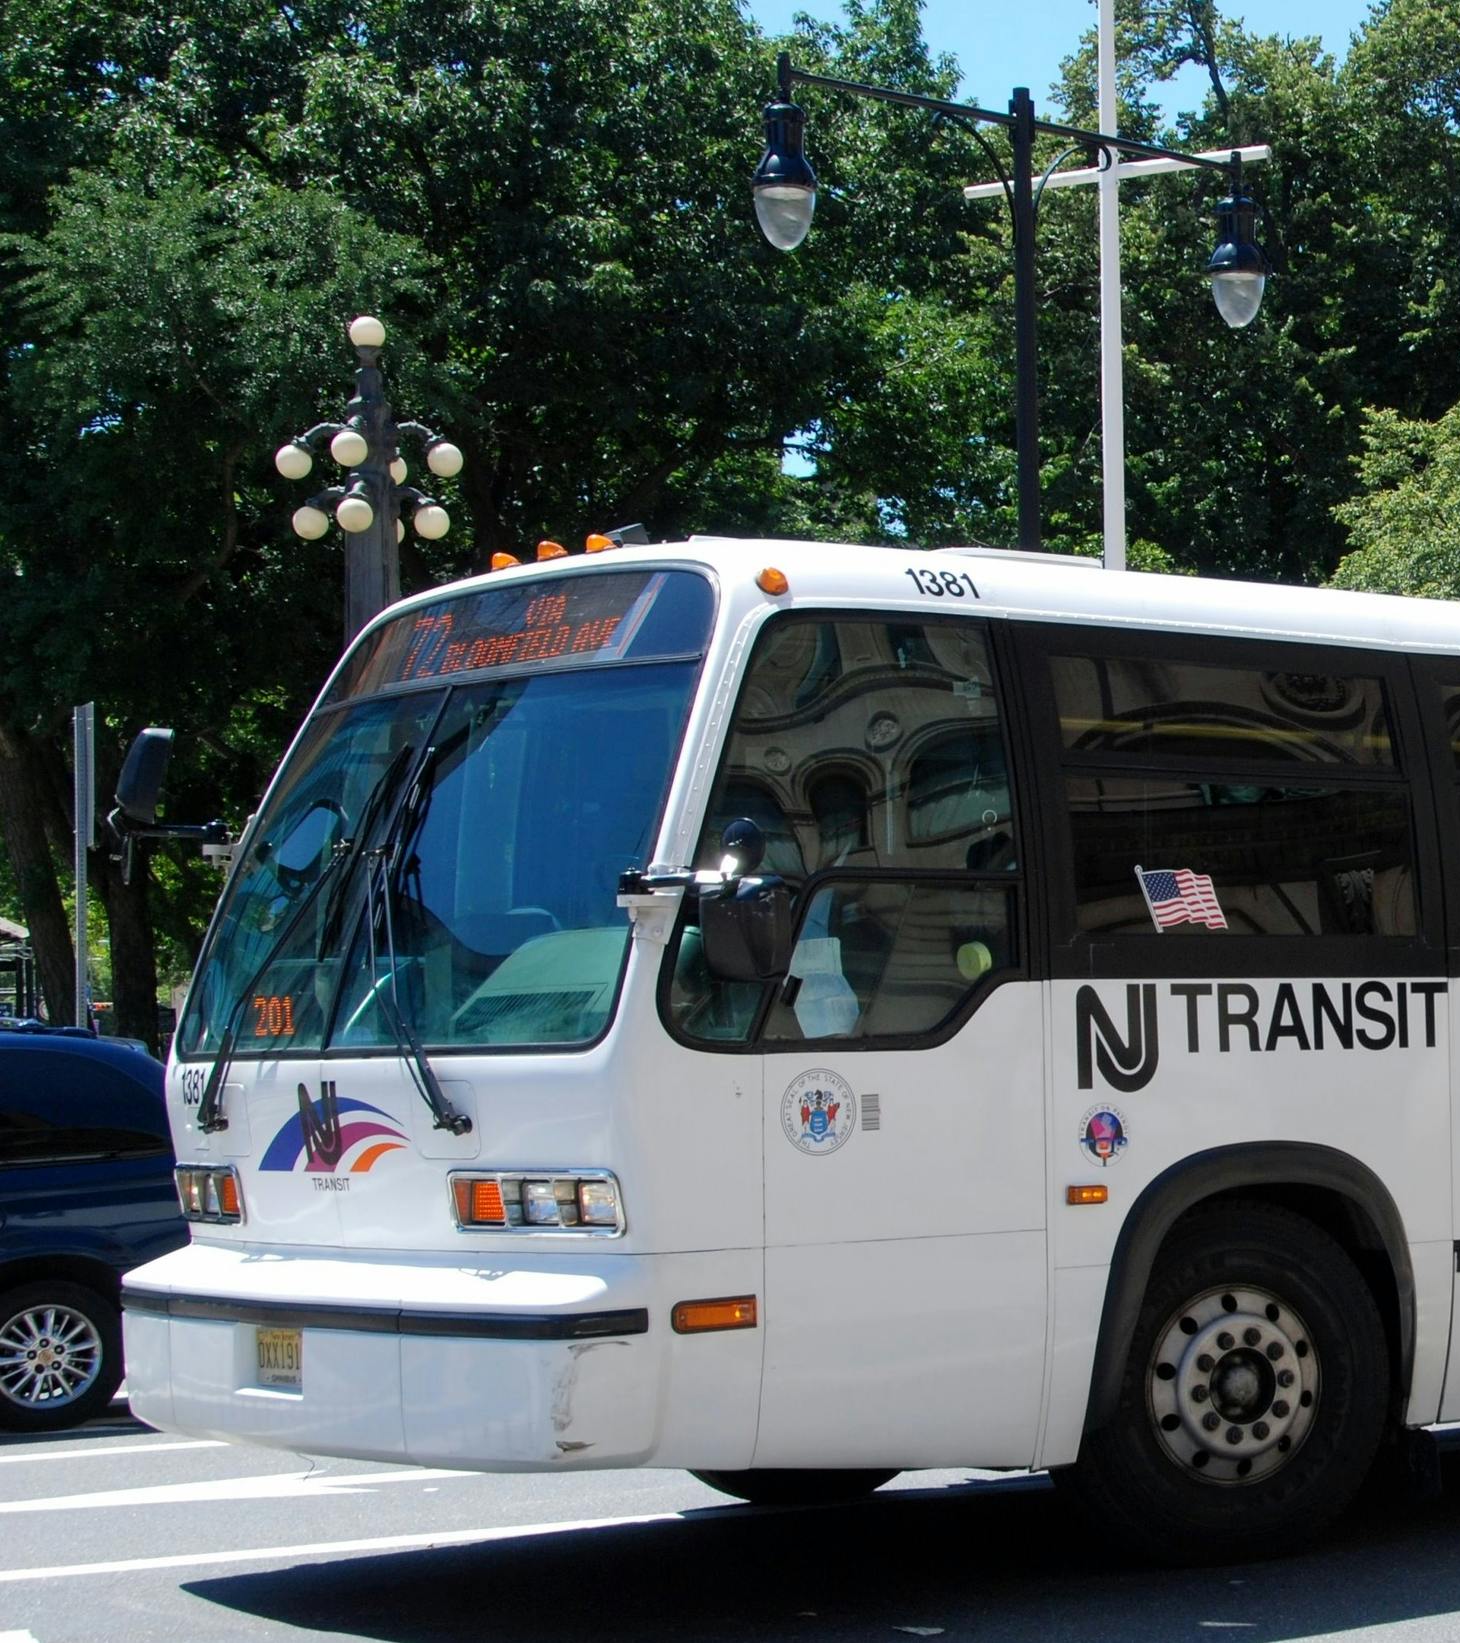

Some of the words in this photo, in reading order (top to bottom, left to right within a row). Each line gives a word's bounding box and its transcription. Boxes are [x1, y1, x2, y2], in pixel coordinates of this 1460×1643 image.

[905, 568, 981, 599] 1381
[402, 613, 453, 681] 72
[253, 995, 296, 1037] 201
[1075, 982, 1160, 1093] NJ
[1170, 981, 1449, 1053] TRANSIT
[182, 1068, 205, 1105] 1381
[311, 1177, 350, 1192] TRANSIT
